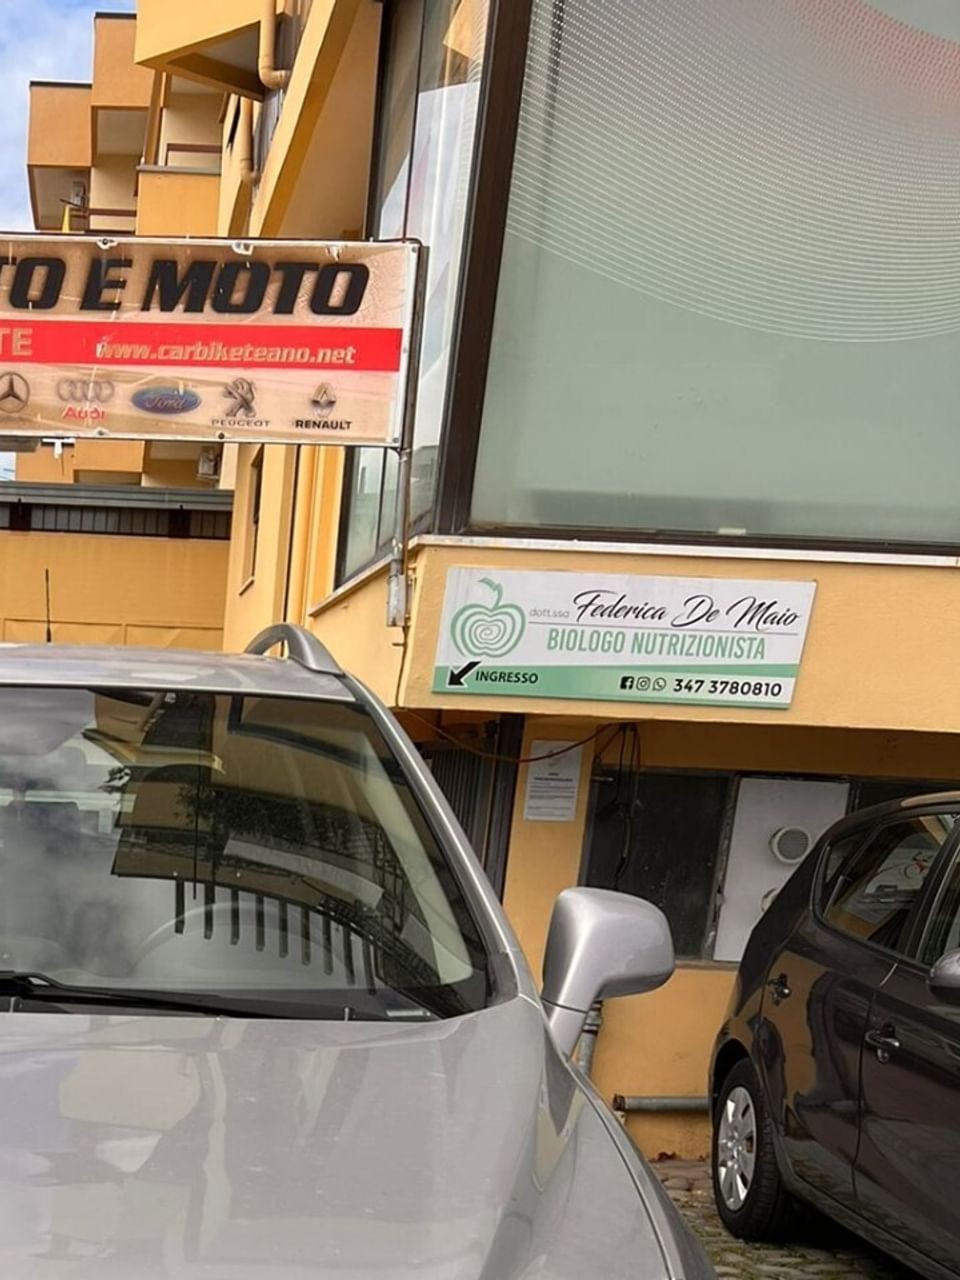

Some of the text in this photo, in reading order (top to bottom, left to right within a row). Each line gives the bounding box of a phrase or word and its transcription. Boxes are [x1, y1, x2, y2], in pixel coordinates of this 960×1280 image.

[79, 257, 133, 312] E
[141, 259, 371, 317] MOTO
[95, 340, 357, 365] www.carbiketeano.net
[144, 395, 185, 410] Ford
[62, 406, 106, 421] Audi
[210, 419, 271, 428] PEUGEOT
[294, 419, 353, 431] RENAULT
[572, 589, 669, 623] Federica
[671, 594, 720, 628] De
[726, 596, 801, 632] Maio
[546, 627, 766, 660] BIOLOGO NUTRIZIONISTA
[475, 670, 539, 684] INGRESSO
[673, 678, 783, 697] 347 3780810
